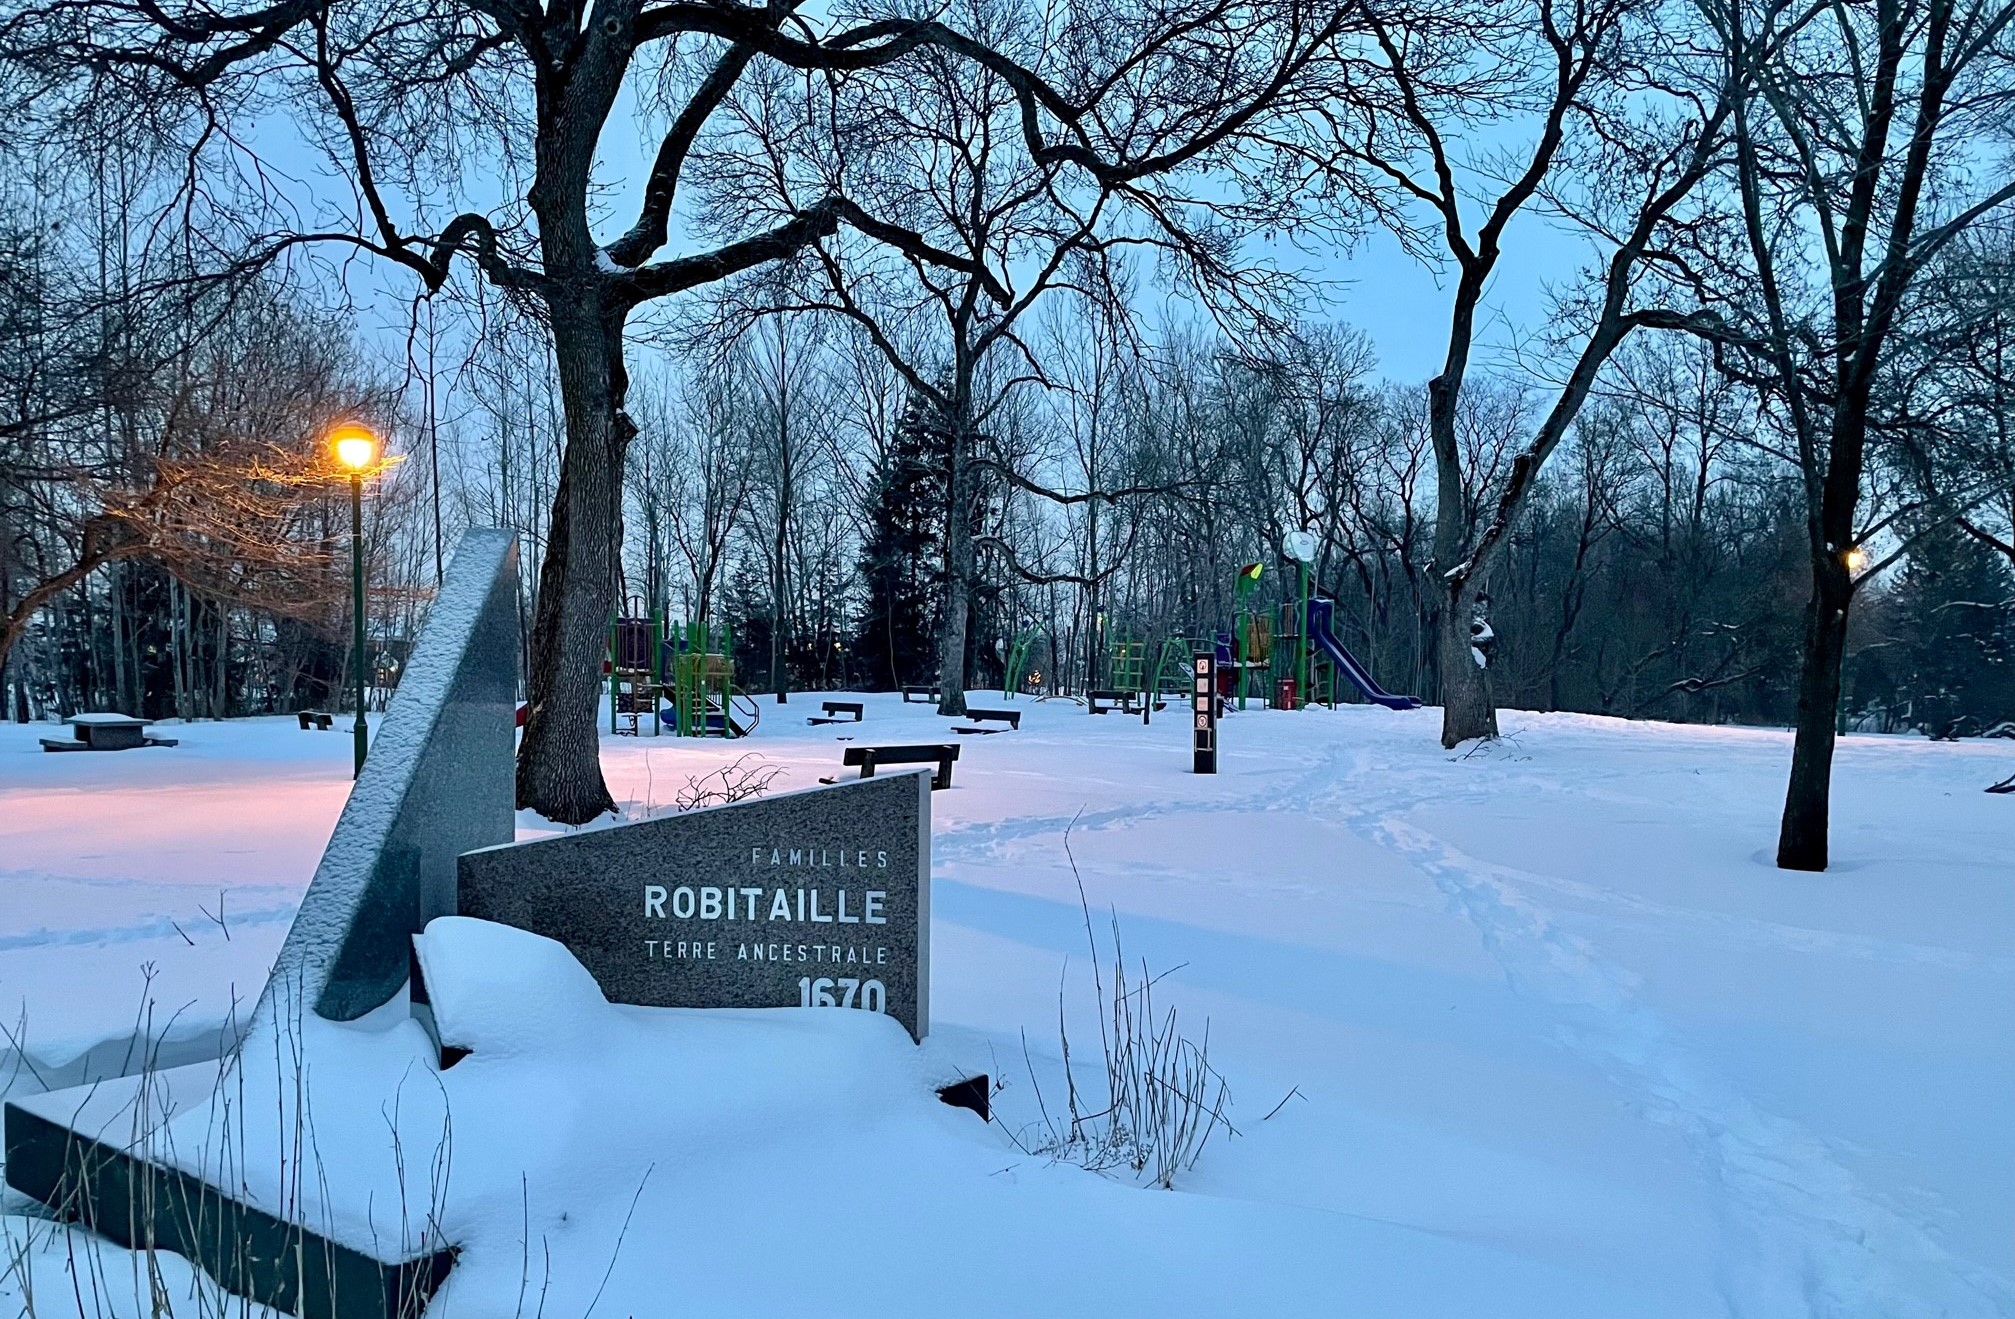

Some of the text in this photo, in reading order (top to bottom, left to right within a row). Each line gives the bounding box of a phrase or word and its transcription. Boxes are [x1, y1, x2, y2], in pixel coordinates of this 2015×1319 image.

[752, 847, 887, 868] FAMILLES
[645, 885, 887, 924] ROBITAILLE
[645, 940, 887, 964] TERRE ANCESTRALE
[798, 976, 887, 1014] 1670
